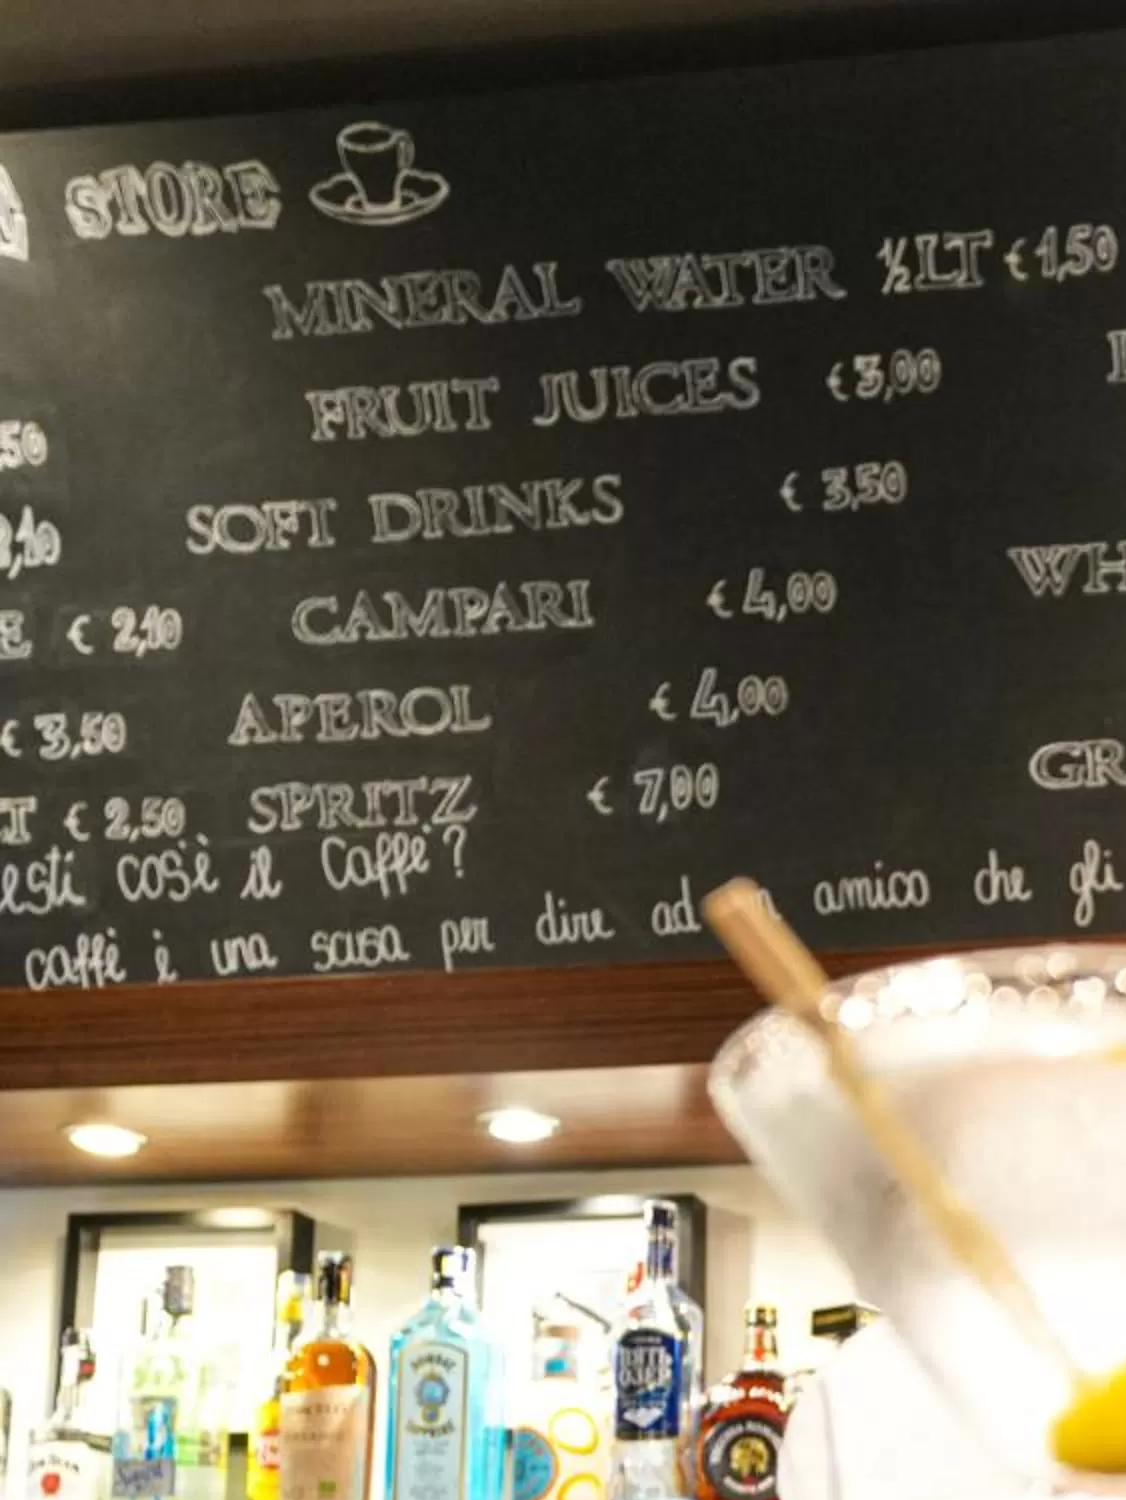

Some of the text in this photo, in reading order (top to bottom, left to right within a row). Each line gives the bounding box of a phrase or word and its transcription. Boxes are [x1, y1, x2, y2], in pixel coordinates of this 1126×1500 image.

[63, 161, 280, 241] STORE
[260, 261, 581, 342] MINERAL
[605, 245, 848, 313] WATER
[304, 377, 500, 442] FRUIT
[531, 356, 761, 427] JUICES
[186, 499, 337, 555] SOFT
[367, 474, 624, 544] DRINKS
[290, 580, 594, 646] CAMPARI
[227, 685, 491, 747] APEROL
[247, 774, 478, 834] SPRITZ
[210, 933, 278, 976] una
[310, 924, 410, 972] scusa
[440, 917, 495, 974] per
[535, 891, 615, 945] dire
[651, 875, 702, 936] ad
[814, 861, 930, 915] amico
[974, 849, 1033, 905] che
[1069, 839, 1124, 927] gli
